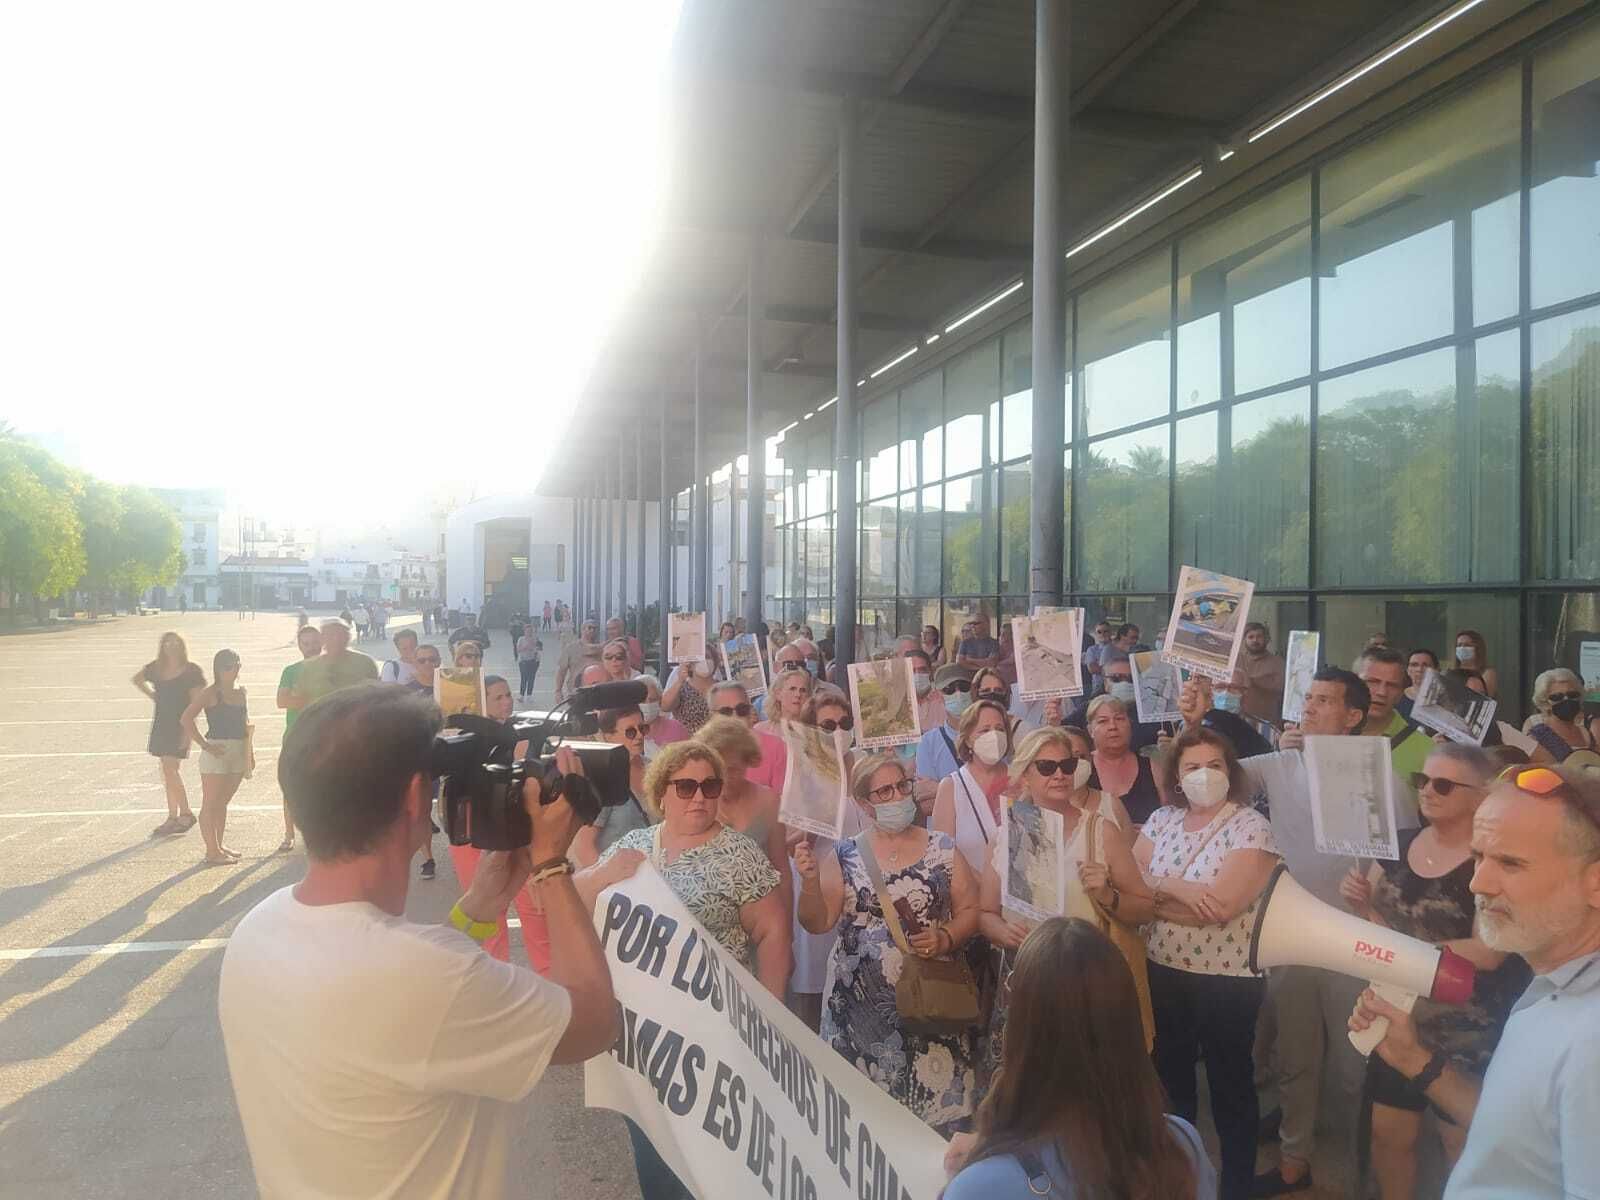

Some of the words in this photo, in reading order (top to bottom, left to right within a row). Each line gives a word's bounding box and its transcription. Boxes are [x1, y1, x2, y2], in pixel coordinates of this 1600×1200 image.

[601, 892, 678, 978] POR
[671, 927, 724, 1012] LOS
[725, 964, 818, 1136] DERECHOS
[823, 1074, 850, 1190] DE
[703, 1060, 746, 1152] ES
[746, 1093, 776, 1198] DE
